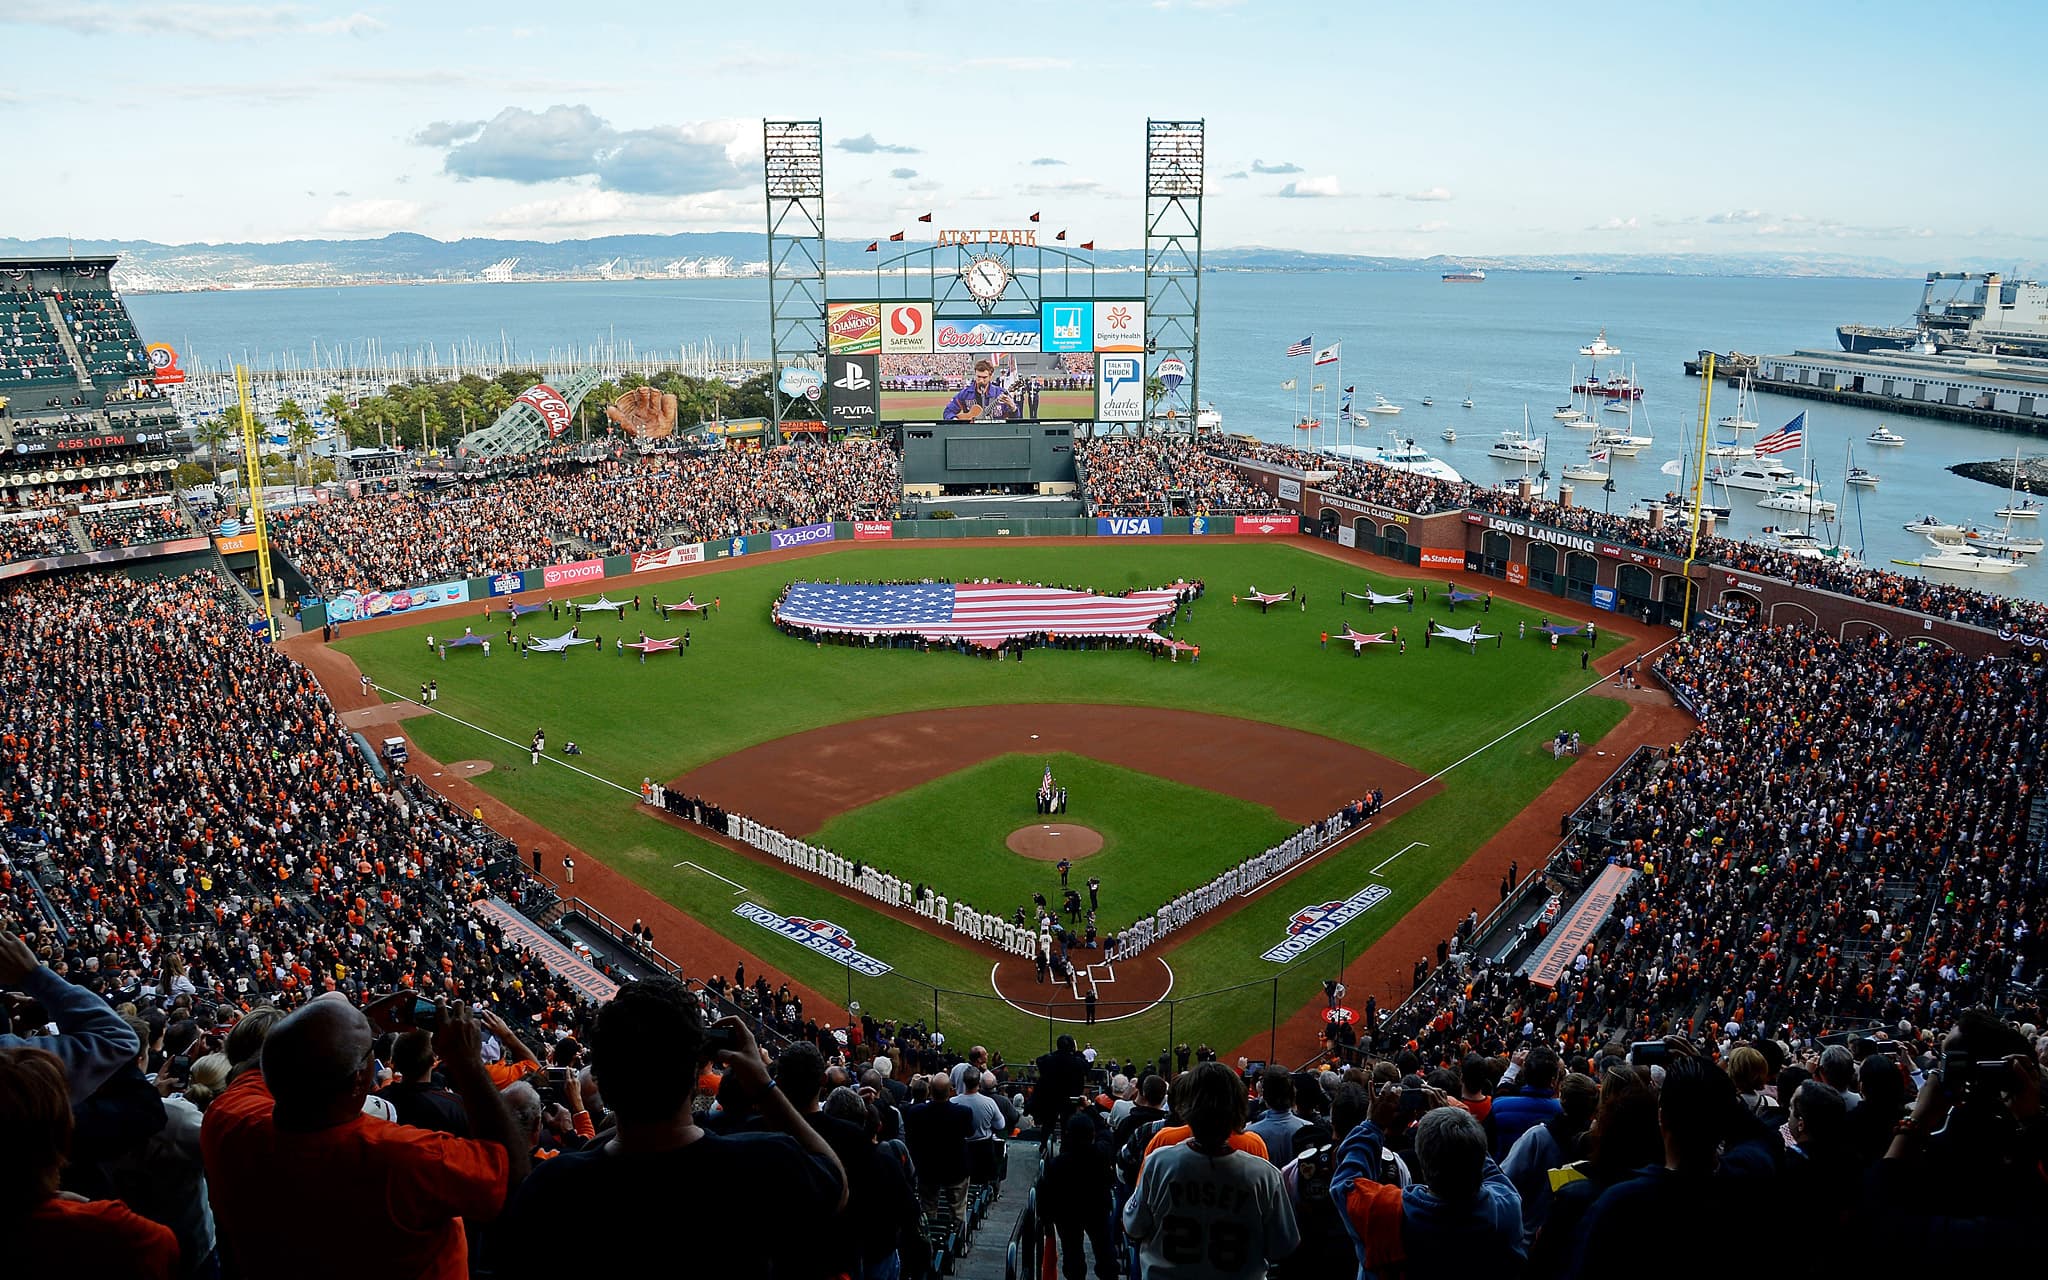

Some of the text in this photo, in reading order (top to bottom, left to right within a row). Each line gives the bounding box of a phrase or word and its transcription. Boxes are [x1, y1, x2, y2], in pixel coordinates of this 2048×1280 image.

[937, 230, 1037, 248] AT&T PARK
[832, 316, 877, 333] DIAMOND
[1055, 326, 1080, 338] PG&E
[938, 326, 1036, 347] Coors LIGHT
[1097, 332, 1120, 341] Dignity
[1104, 398, 1140, 409] charles
[1104, 409, 1140, 417] SCHWAB
[57, 436, 125, 448] 4:55:10 PM
[147, 432, 163, 440] at&t
[1326, 497, 1409, 524] WORLD BASEBALL CLASSIC 2013
[1108, 519, 1150, 534] VISA
[774, 526, 832, 547] YAHOO!
[1528, 527, 1595, 552] LANDING
[222, 540, 244, 551] at&t
[677, 547, 690, 555] WALK
[562, 565, 602, 579] TOYOTA
[1737, 582, 1762, 592] america
[1264, 886, 1388, 962] WORLD SERIES
[736, 902, 888, 976] WORLD SERIES
[1538, 893, 1611, 980] WELCOME TO AT&T PARK
[490, 910, 616, 998] SAN FRANCISCO GIANTS
